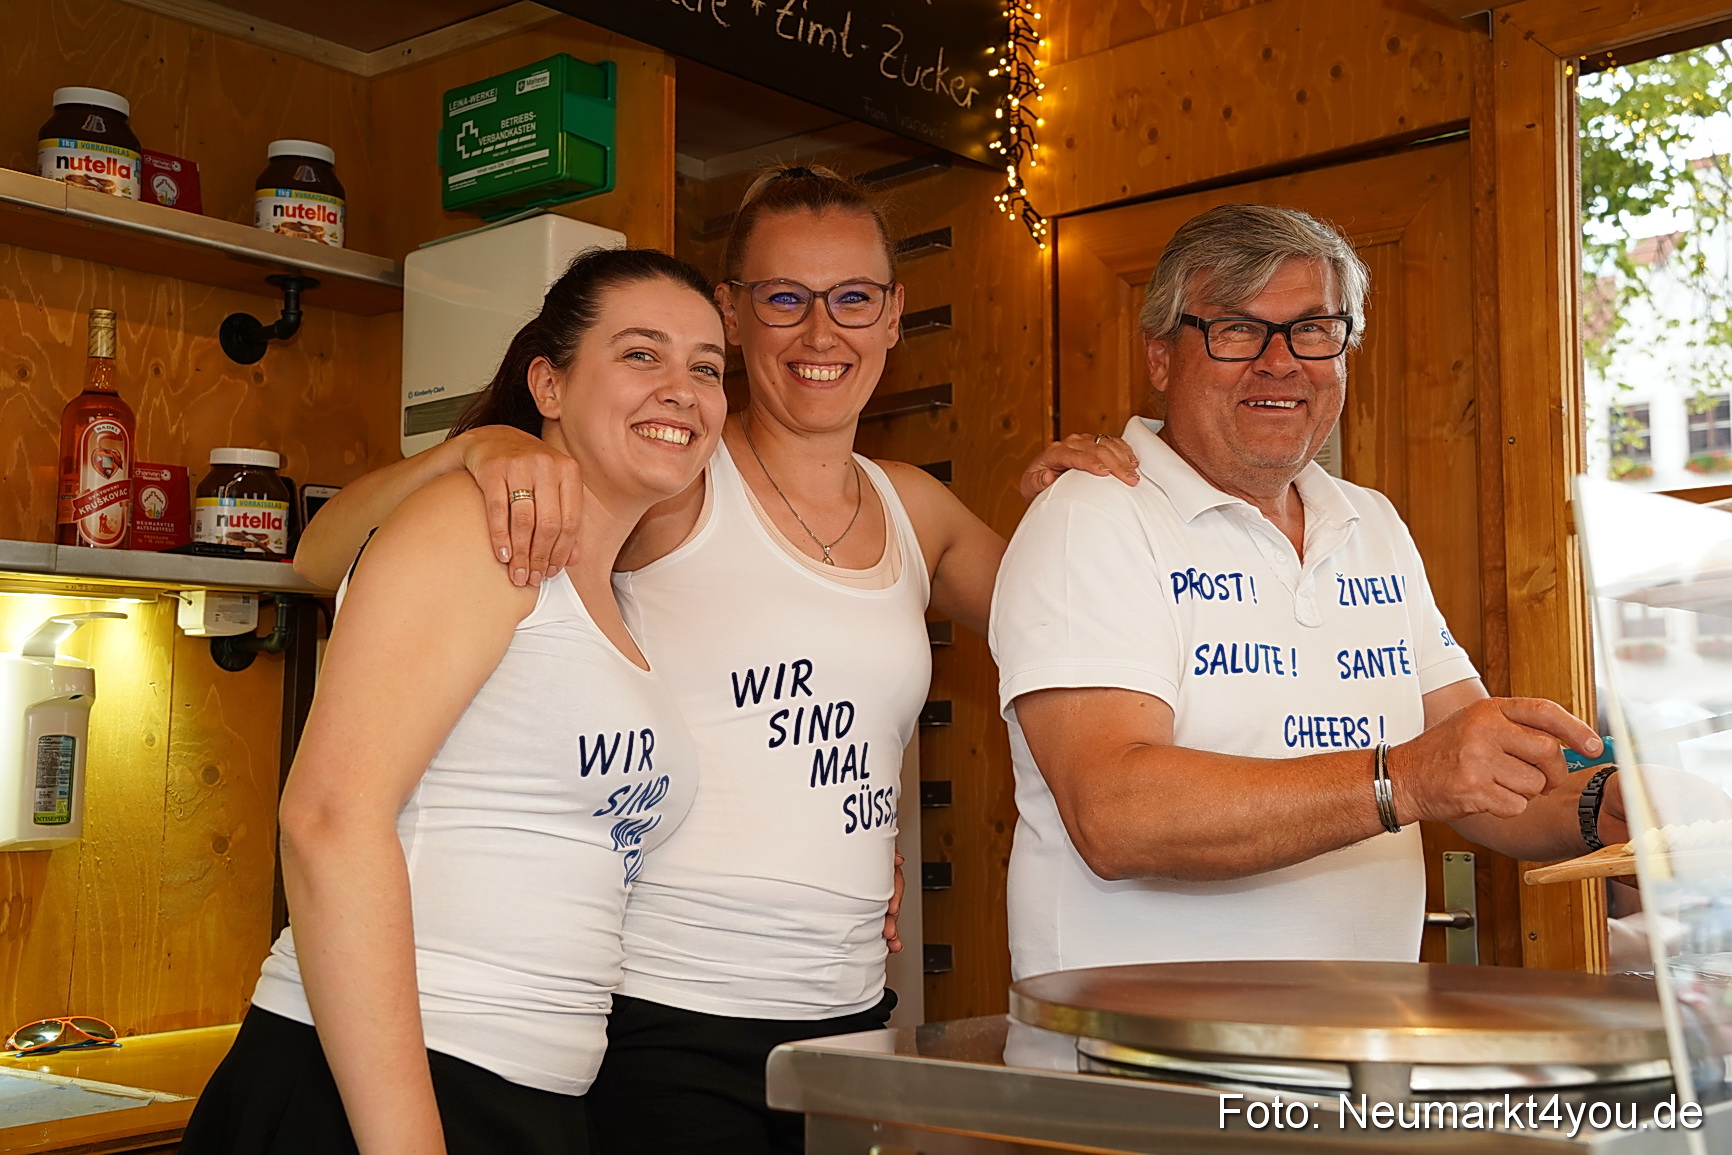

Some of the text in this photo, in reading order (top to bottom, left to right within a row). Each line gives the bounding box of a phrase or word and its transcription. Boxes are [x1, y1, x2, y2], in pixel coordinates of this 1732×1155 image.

[527, 75, 548, 86] Malteser
[448, 88, 496, 111] LEINA-WERKE
[500, 111, 537, 129] BETRIEBS-
[478, 122, 537, 147] VERBANDKASTEN
[61, 139, 130, 157] 1kg VORRATSGLAS
[56, 155, 131, 180] nutella
[277, 189, 290, 198] 1kg
[273, 203, 338, 225] nutella
[414, 386, 445, 397] Kimberly-Clark
[78, 488, 128, 516] KRUŠKOVAC
[239, 500, 282, 509] VORRATSGLAS
[136, 520, 175, 528] NEUMARKTER
[136, 525, 175, 533] ALTSTADTFEST
[216, 511, 283, 531] nutella
[731, 659, 813, 708] WIR
[769, 701, 855, 748] SIND
[579, 728, 655, 778] WIR
[810, 741, 870, 788] MAL
[592, 775, 670, 817] SIND
[611, 814, 662, 852] MAL
